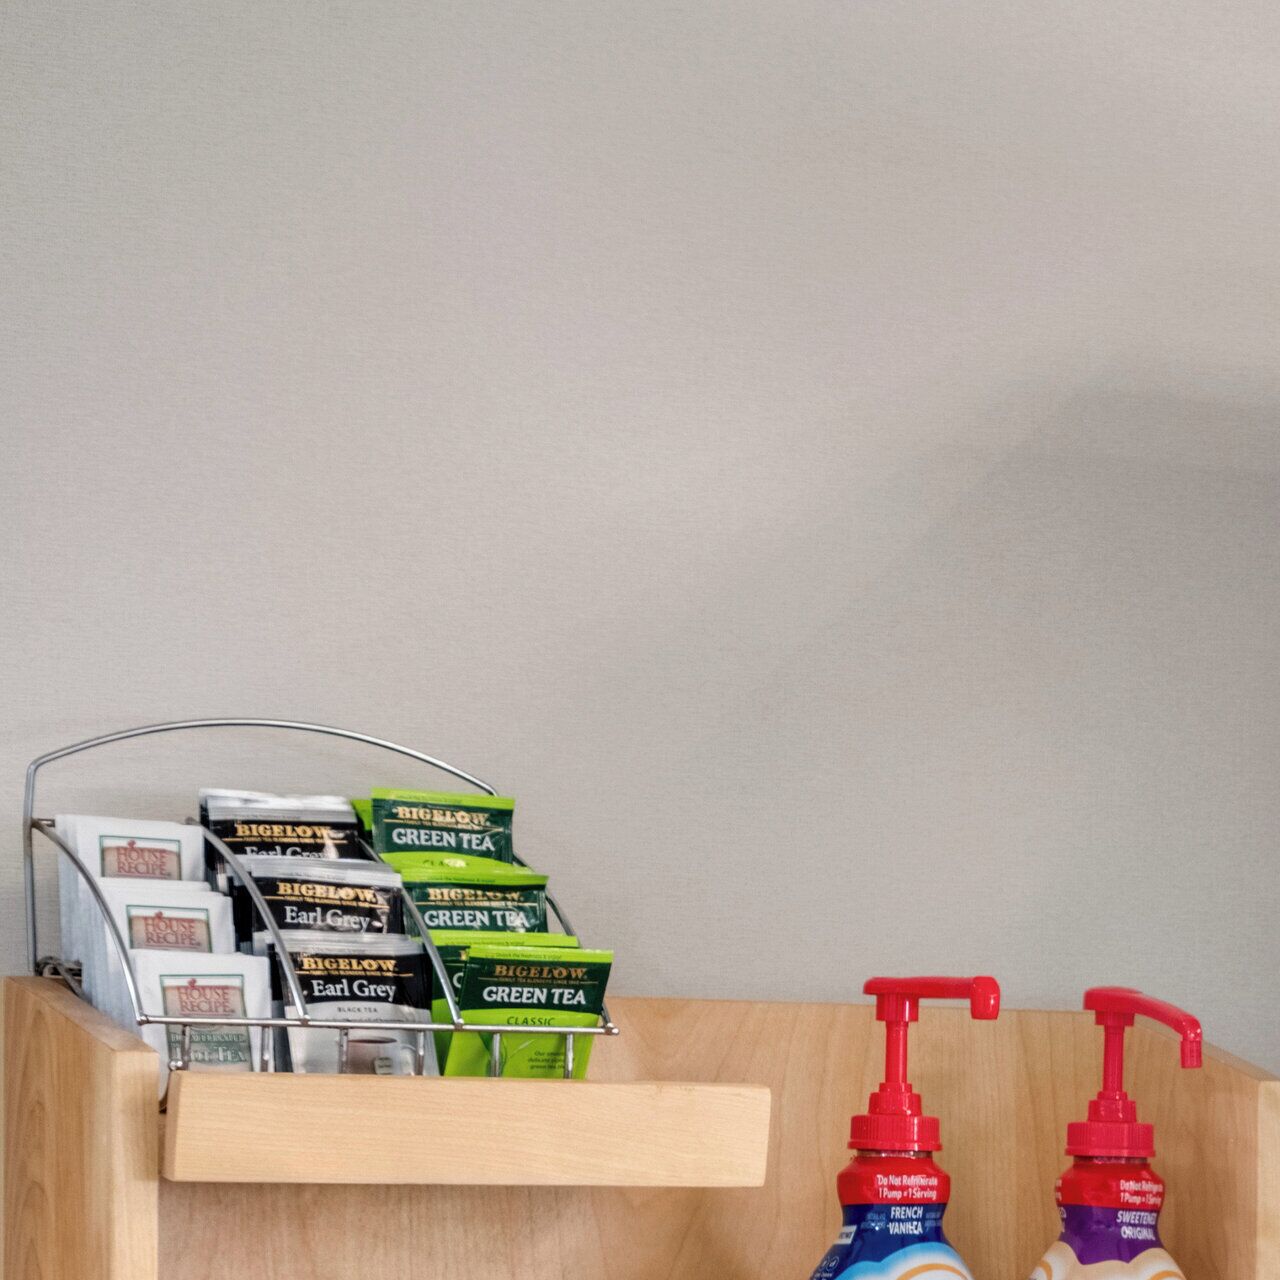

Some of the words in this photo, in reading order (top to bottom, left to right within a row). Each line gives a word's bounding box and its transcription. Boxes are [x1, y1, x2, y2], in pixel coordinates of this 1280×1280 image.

[396, 806, 491, 827] BIGELOW
[235, 824, 331, 839] BIGELOW
[391, 828, 457, 848] GREEN
[459, 832, 496, 851] TEA
[116, 847, 168, 862] HOUSE
[117, 861, 168, 876] RECIPE
[276, 881, 378, 904] BIGELOW
[427, 887, 524, 902] BIGELOW
[144, 917, 197, 933] HOUSE
[284, 905, 322, 926] Earl
[326, 908, 371, 935] Grey
[424, 909, 490, 927] GREEN
[492, 910, 531, 928] TEA
[145, 931, 197, 946] RECIPE
[301, 957, 397, 972] BIGELOW
[493, 964, 588, 980] BIGELOW
[176, 986, 230, 1001] HOUSE
[310, 979, 350, 997] Earl
[352, 979, 396, 1002] Grey
[482, 986, 548, 1004] GREEN
[550, 988, 587, 1005] TEA
[179, 1000, 231, 1014] RECIPE
[506, 1016, 556, 1026] CLASSIC
[876, 1174, 888, 1185] Do
[888, 1174, 902, 1186] Not
[1119, 1179, 1130, 1191] Do
[1129, 1180, 1142, 1192] Not
[878, 1187, 883, 1199] 1
[883, 1187, 902, 1201] Pump
[908, 1188, 913, 1199] 1
[913, 1186, 937, 1201] Serving
[1120, 1192, 1125, 1203] 1
[1124, 1192, 1142, 1206] Pump
[890, 1206, 924, 1219] FRENCH
[1120, 1225, 1157, 1241] ORIGINAL
